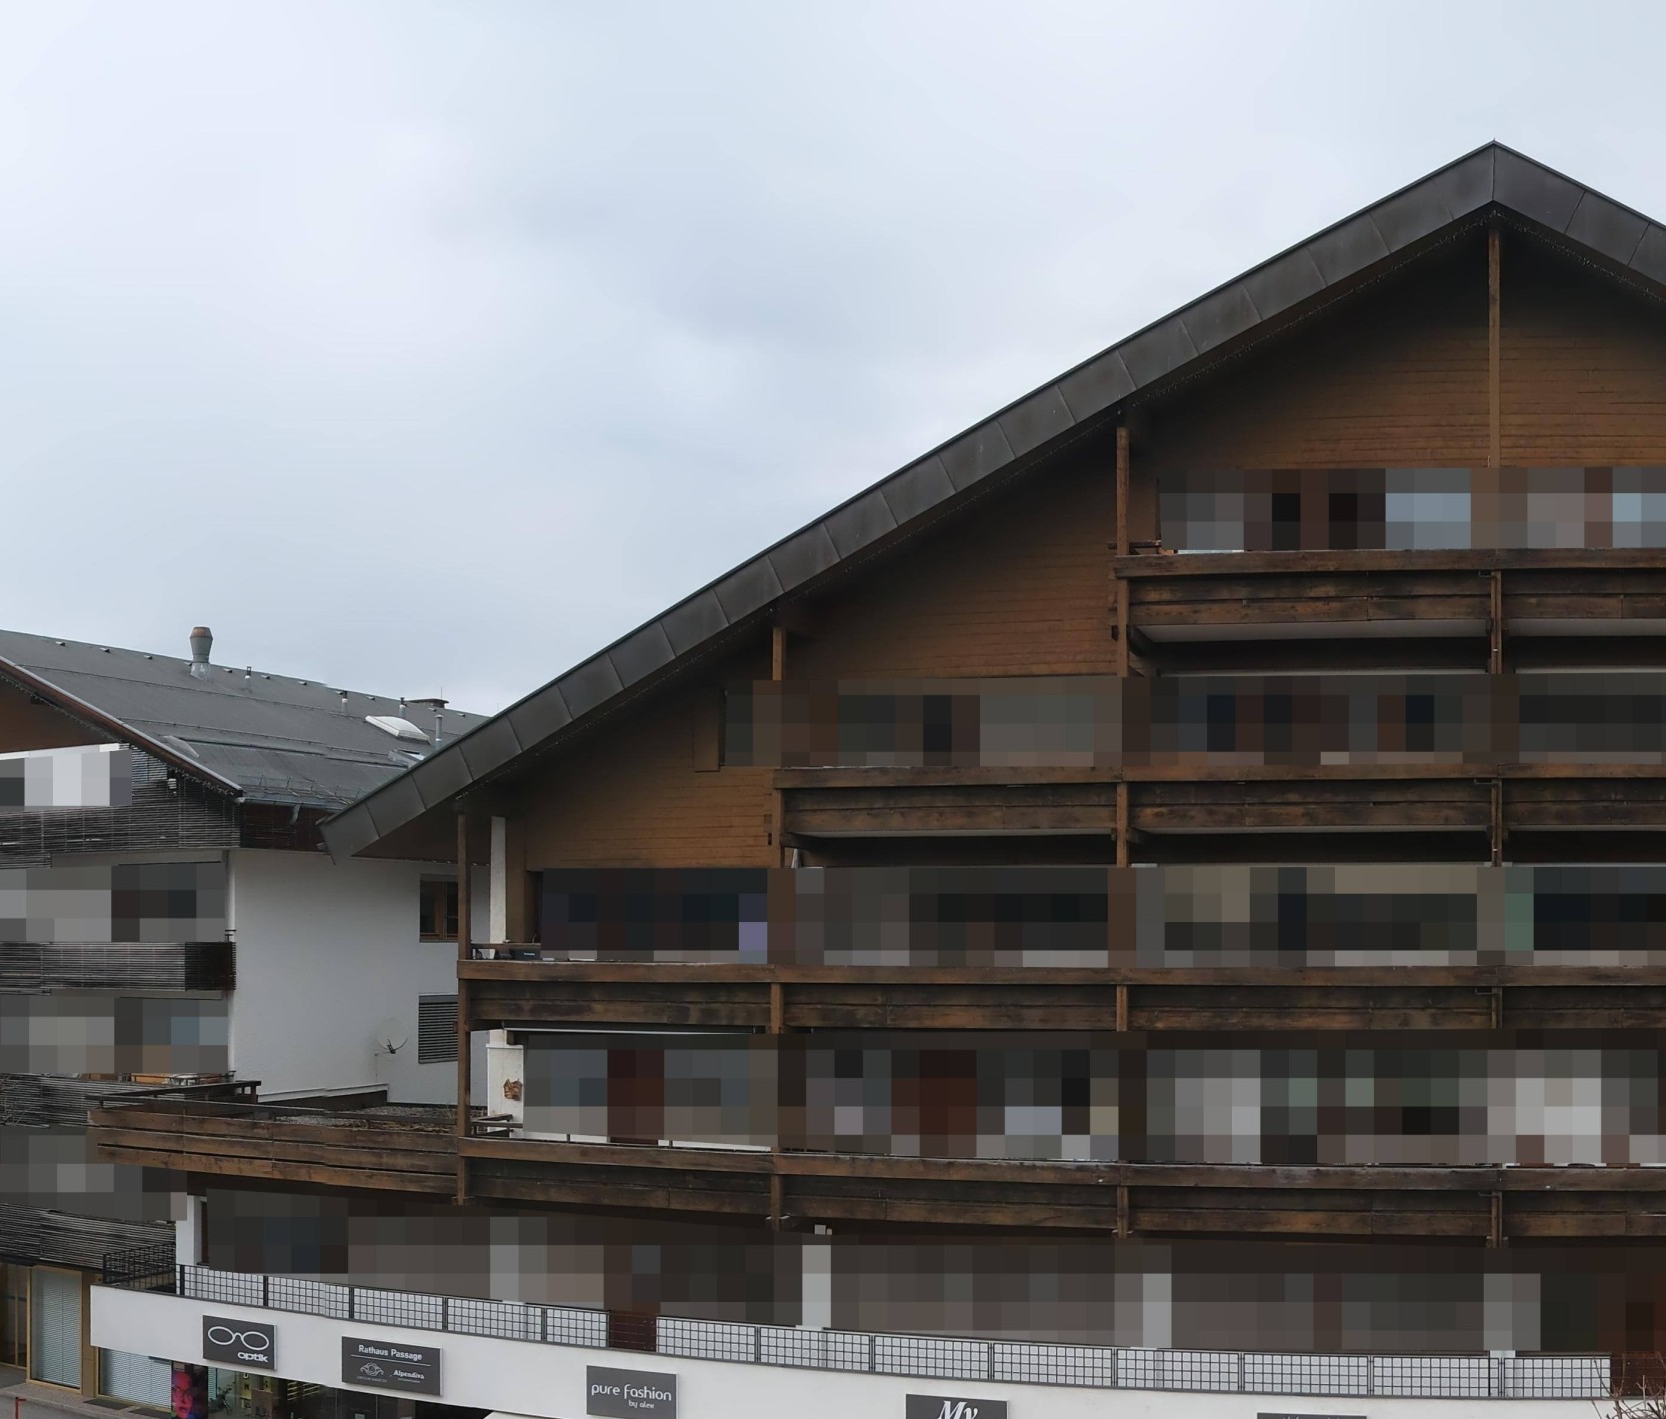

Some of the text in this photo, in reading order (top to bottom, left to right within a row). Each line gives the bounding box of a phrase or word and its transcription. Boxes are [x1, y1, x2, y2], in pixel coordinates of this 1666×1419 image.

[237, 1351, 269, 1363] optik
[358, 1344, 423, 1362] Rathaus Passage
[591, 1383, 672, 1401] pure fashion
[628, 1399, 655, 1409] by alex
